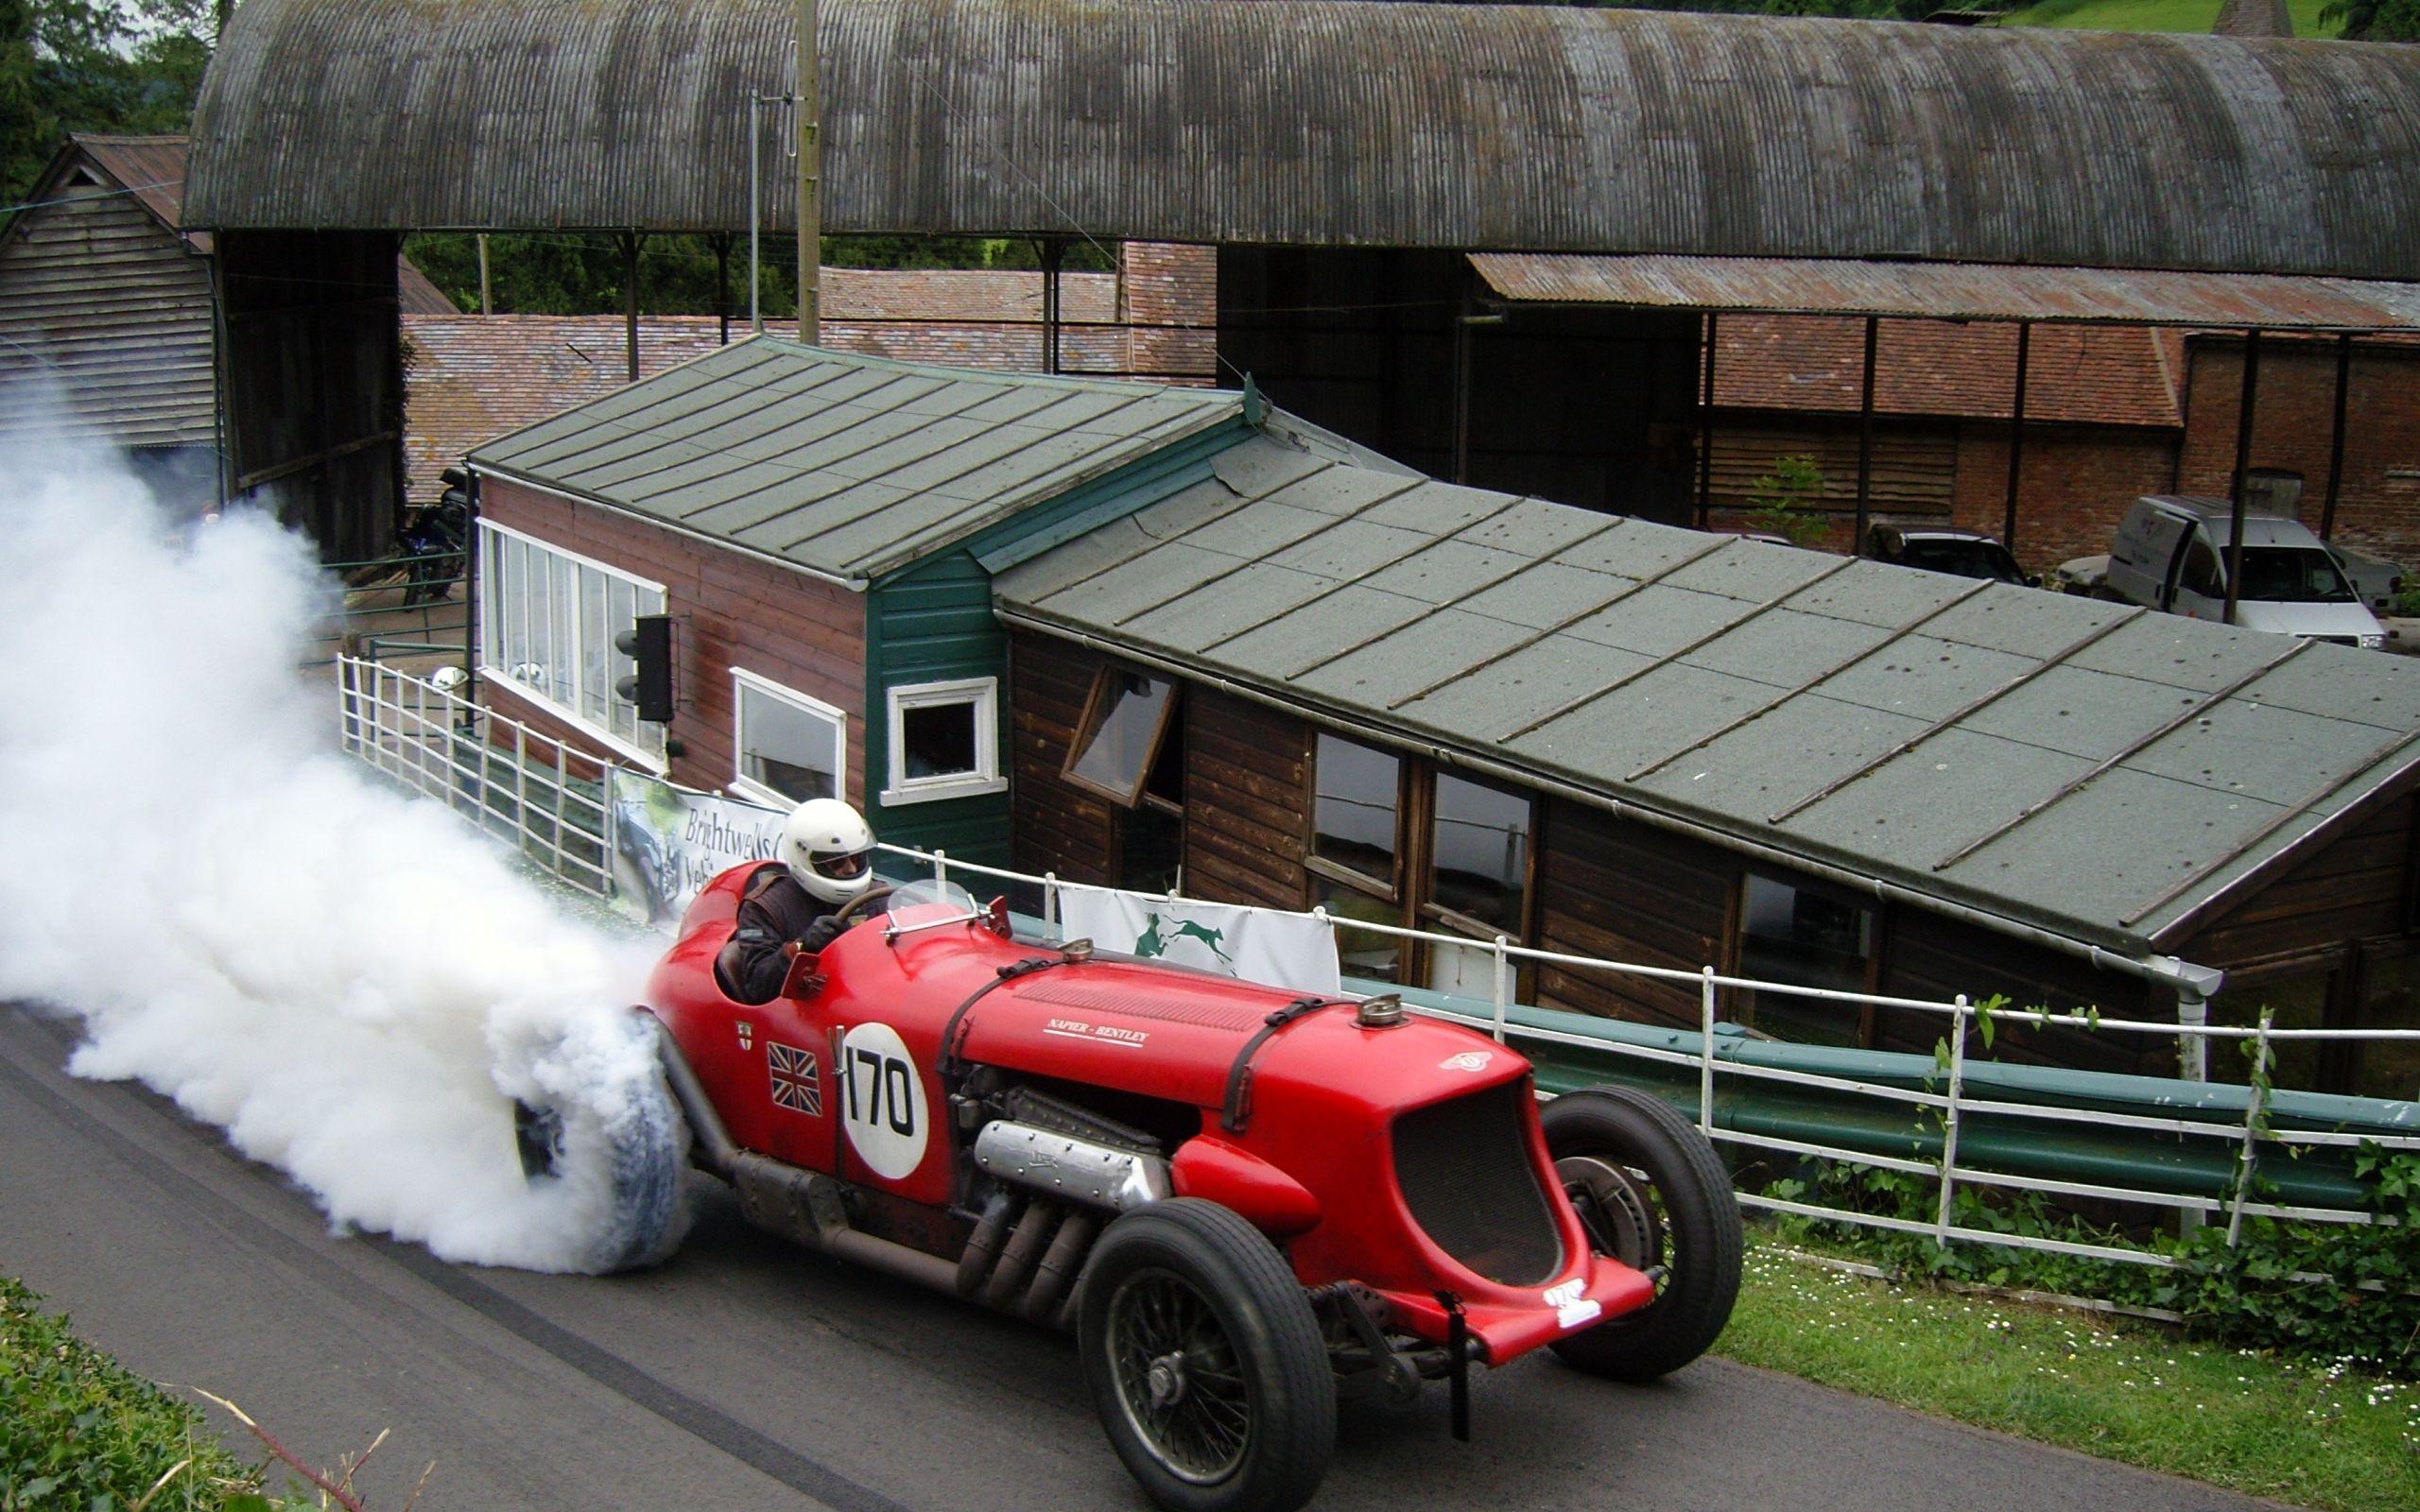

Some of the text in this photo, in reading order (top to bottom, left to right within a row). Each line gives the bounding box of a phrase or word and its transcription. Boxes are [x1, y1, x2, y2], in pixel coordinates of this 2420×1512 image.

[685, 808, 771, 861] Brightwells
[1047, 1019, 1089, 1033] NAPIER
[1096, 1026, 1150, 1041] BENTLEY
[846, 1045, 915, 1138] 170
